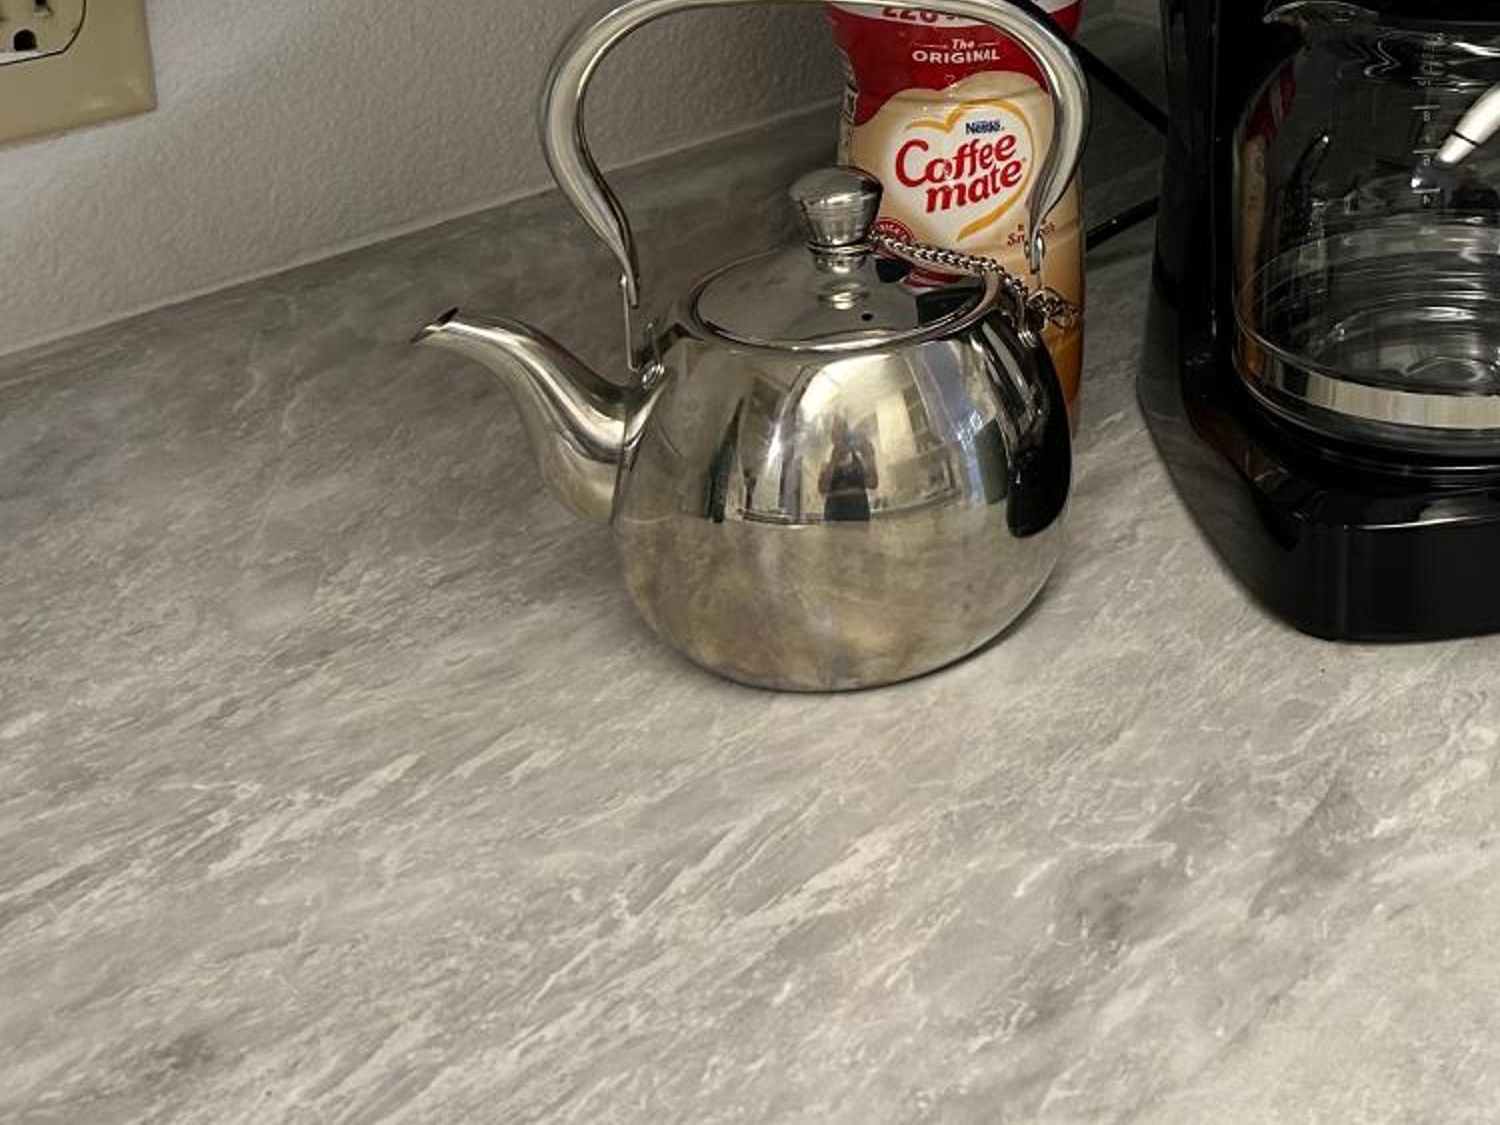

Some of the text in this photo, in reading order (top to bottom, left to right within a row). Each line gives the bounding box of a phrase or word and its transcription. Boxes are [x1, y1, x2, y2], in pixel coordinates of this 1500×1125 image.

[911, 48, 1001, 64] ORIGINAL
[952, 38, 975, 51] The
[895, 134, 1017, 188] Coffee
[925, 160, 1023, 213] mate
